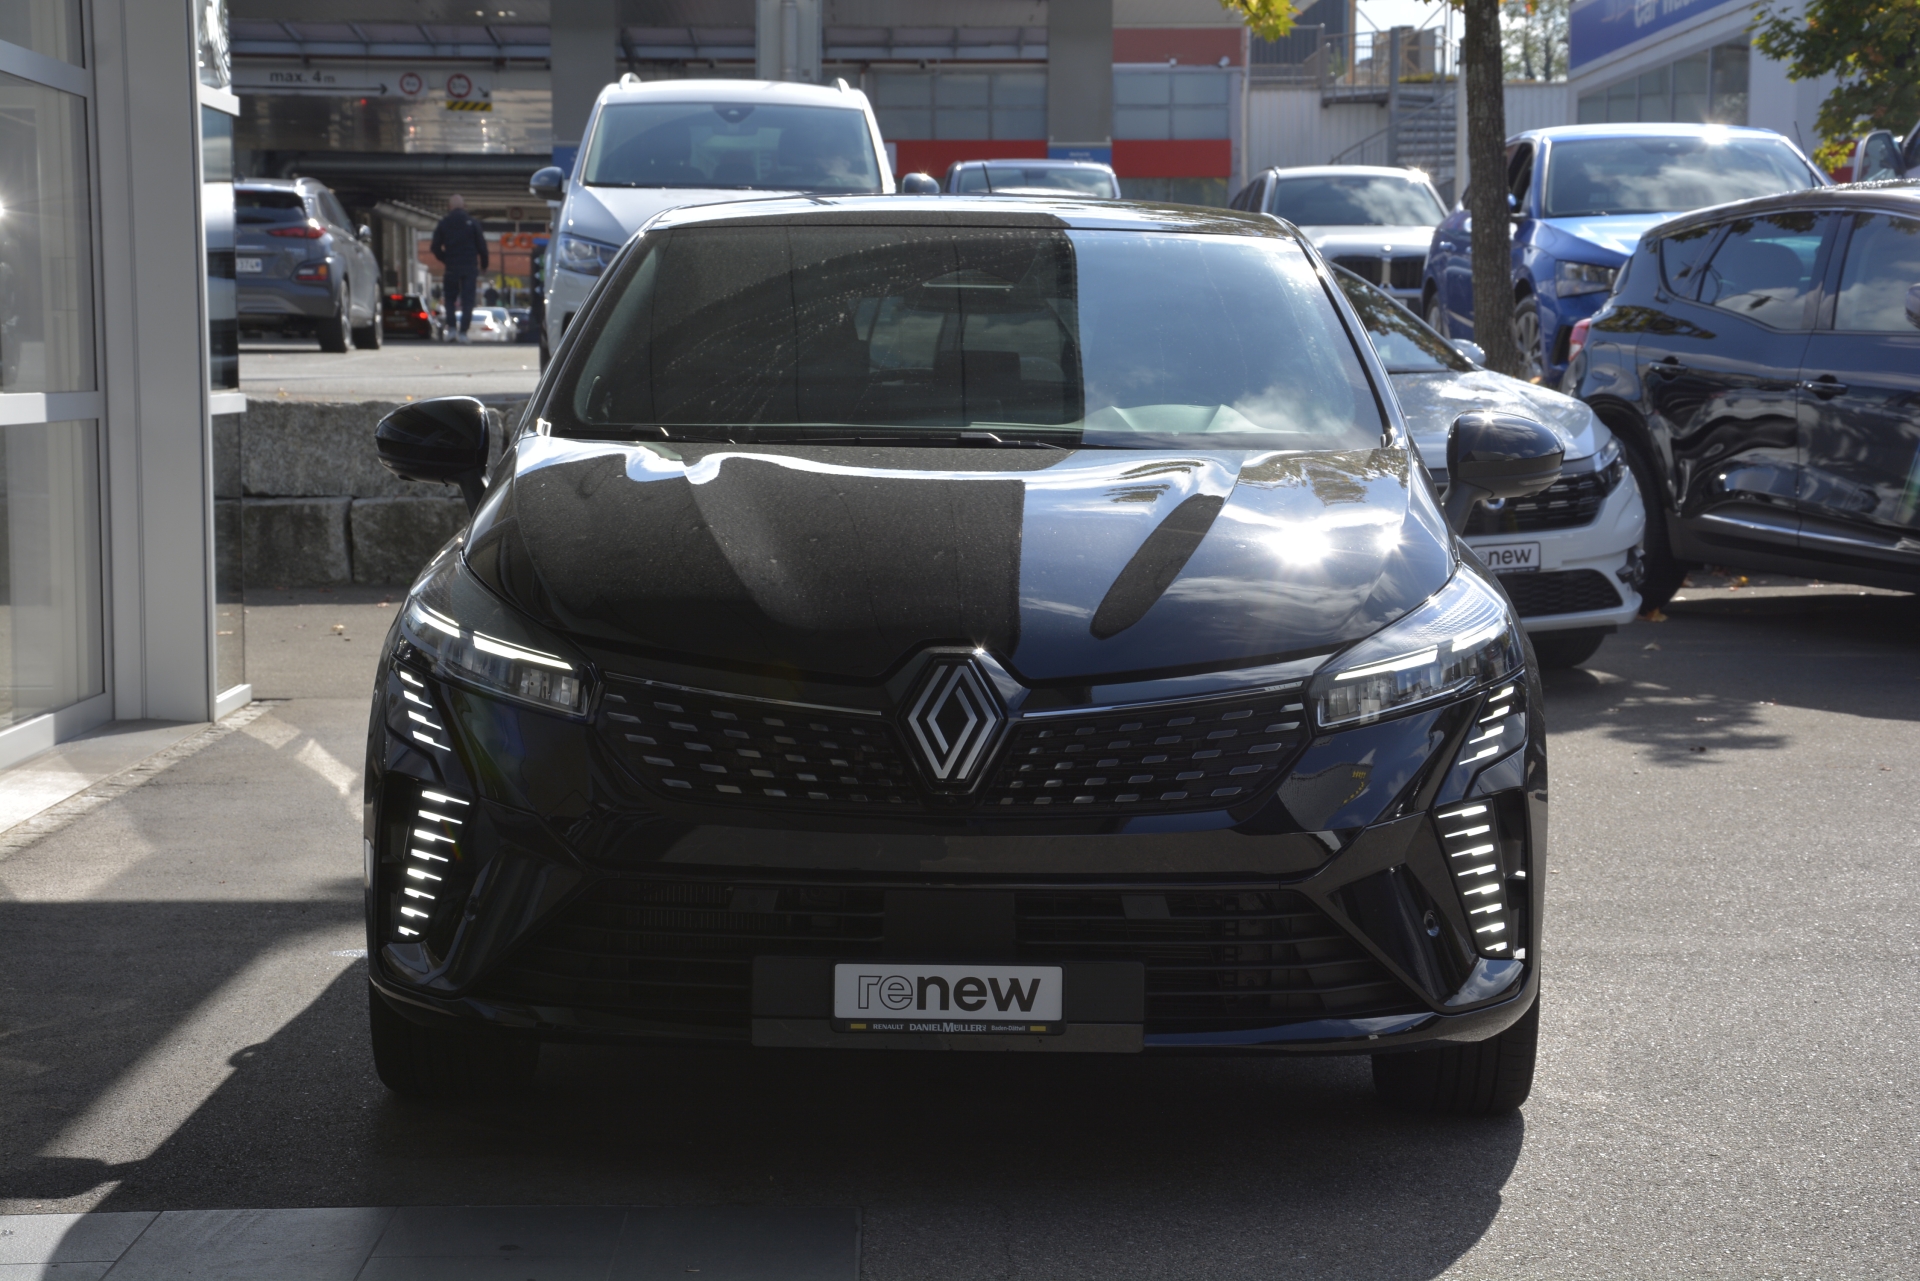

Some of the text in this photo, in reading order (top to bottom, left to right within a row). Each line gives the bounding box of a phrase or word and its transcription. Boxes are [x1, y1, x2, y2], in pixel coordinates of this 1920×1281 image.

[270, 72, 308, 83] max.
[1477, 548, 1532, 566] enew
[858, 975, 1041, 1012] renew
